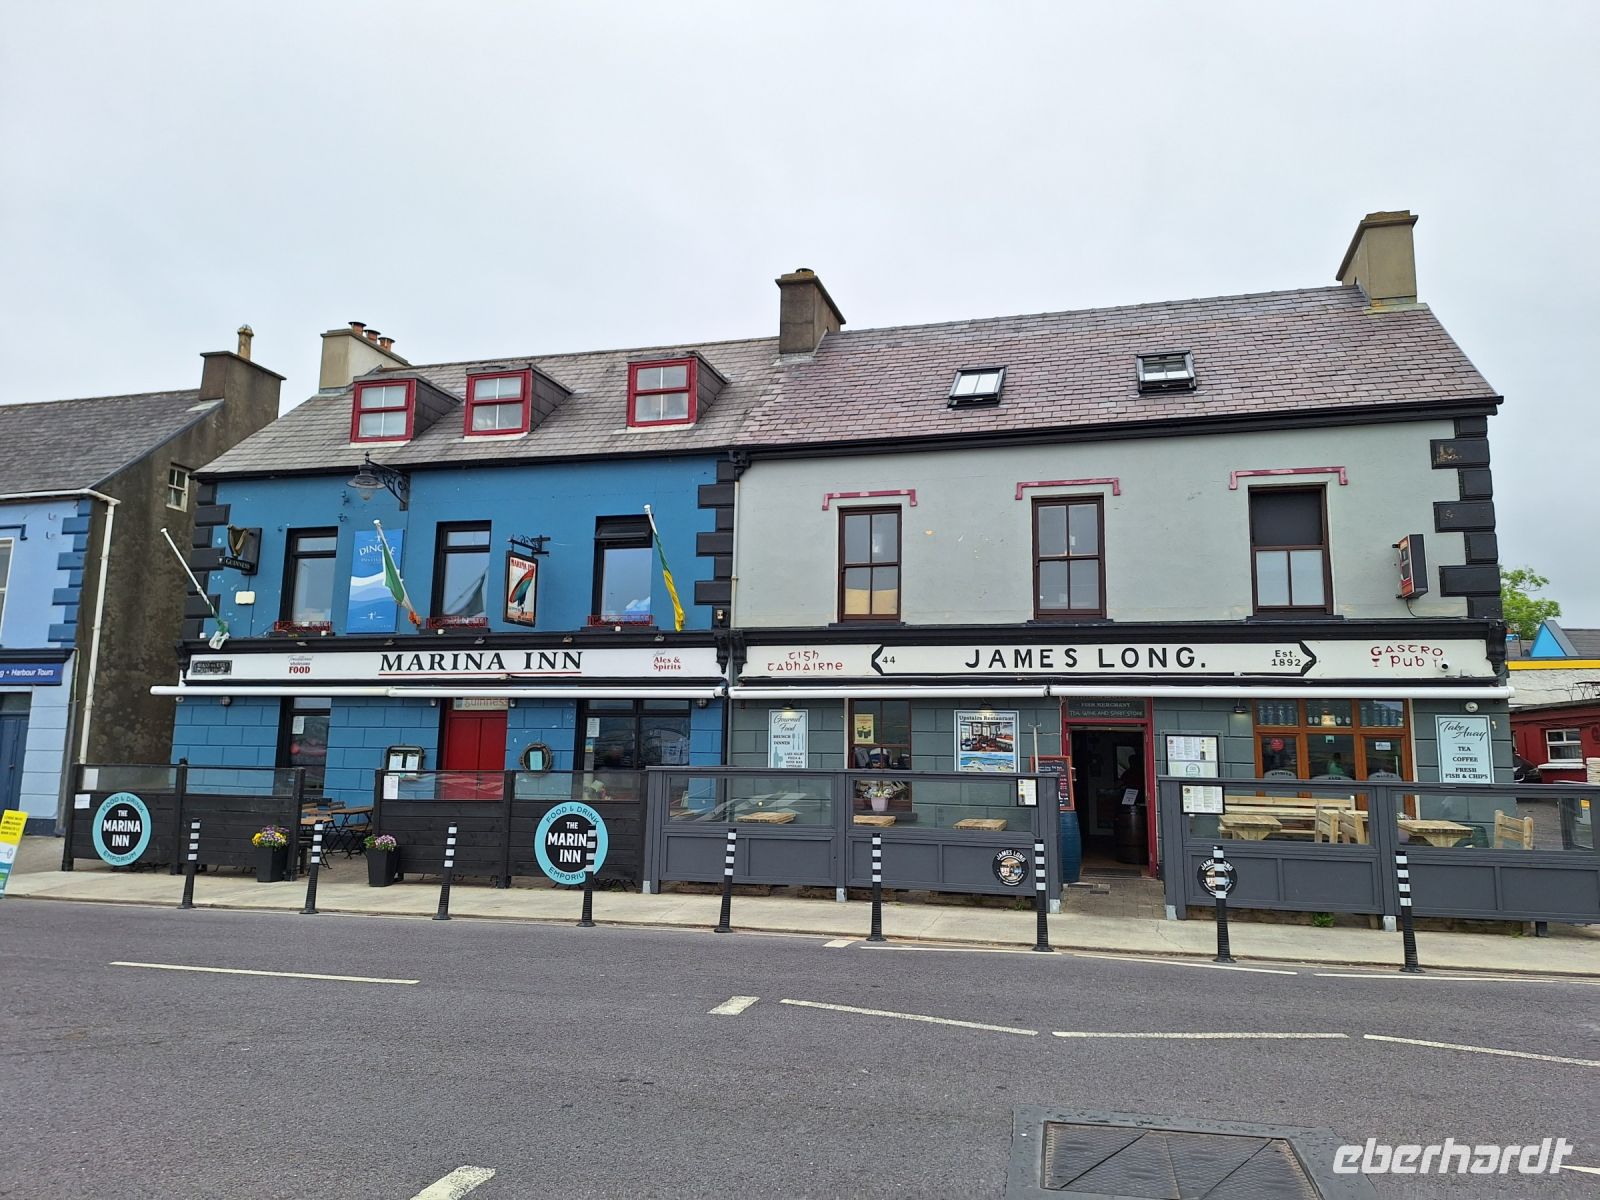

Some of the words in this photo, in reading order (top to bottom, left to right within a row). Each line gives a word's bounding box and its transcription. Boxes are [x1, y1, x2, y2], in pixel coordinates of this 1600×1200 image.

[359, 544, 397, 556] DINGE
[511, 559, 528, 570] MARINA
[1274, 650, 1297, 658] Est.
[1370, 645, 1443, 657] GASTRO
[379, 652, 506, 671] MARINA
[523, 651, 584, 670] INN
[882, 656, 896, 664] 44
[965, 648, 1079, 669] JAMES
[1271, 658, 1301, 667] 1892
[37, 668, 54, 676] Tours
[288, 666, 311, 674] FOOD
[653, 663, 682, 672] Spirits
[779, 722, 797, 733] Food
[1440, 720, 1465, 732] Take
[1451, 726, 1487, 741] Away
[102, 796, 120, 812] FOOD
[126, 796, 145, 814] DRINK
[117, 809, 129, 817] THE
[545, 806, 568, 824] FOOD
[576, 806, 600, 825] DRINK
[102, 819, 141, 833] MARINA
[566, 821, 579, 830] THE
[111, 834, 130, 847] INN
[547, 832, 588, 847] MARIN
[103, 850, 137, 862] EMPORIUM
[559, 849, 582, 863] INN
[996, 849, 1013, 860] JAMES
[1013, 851, 1027, 862] LONG
[1200, 859, 1215, 870] JAME
[548, 866, 586, 881] EMPORIU
